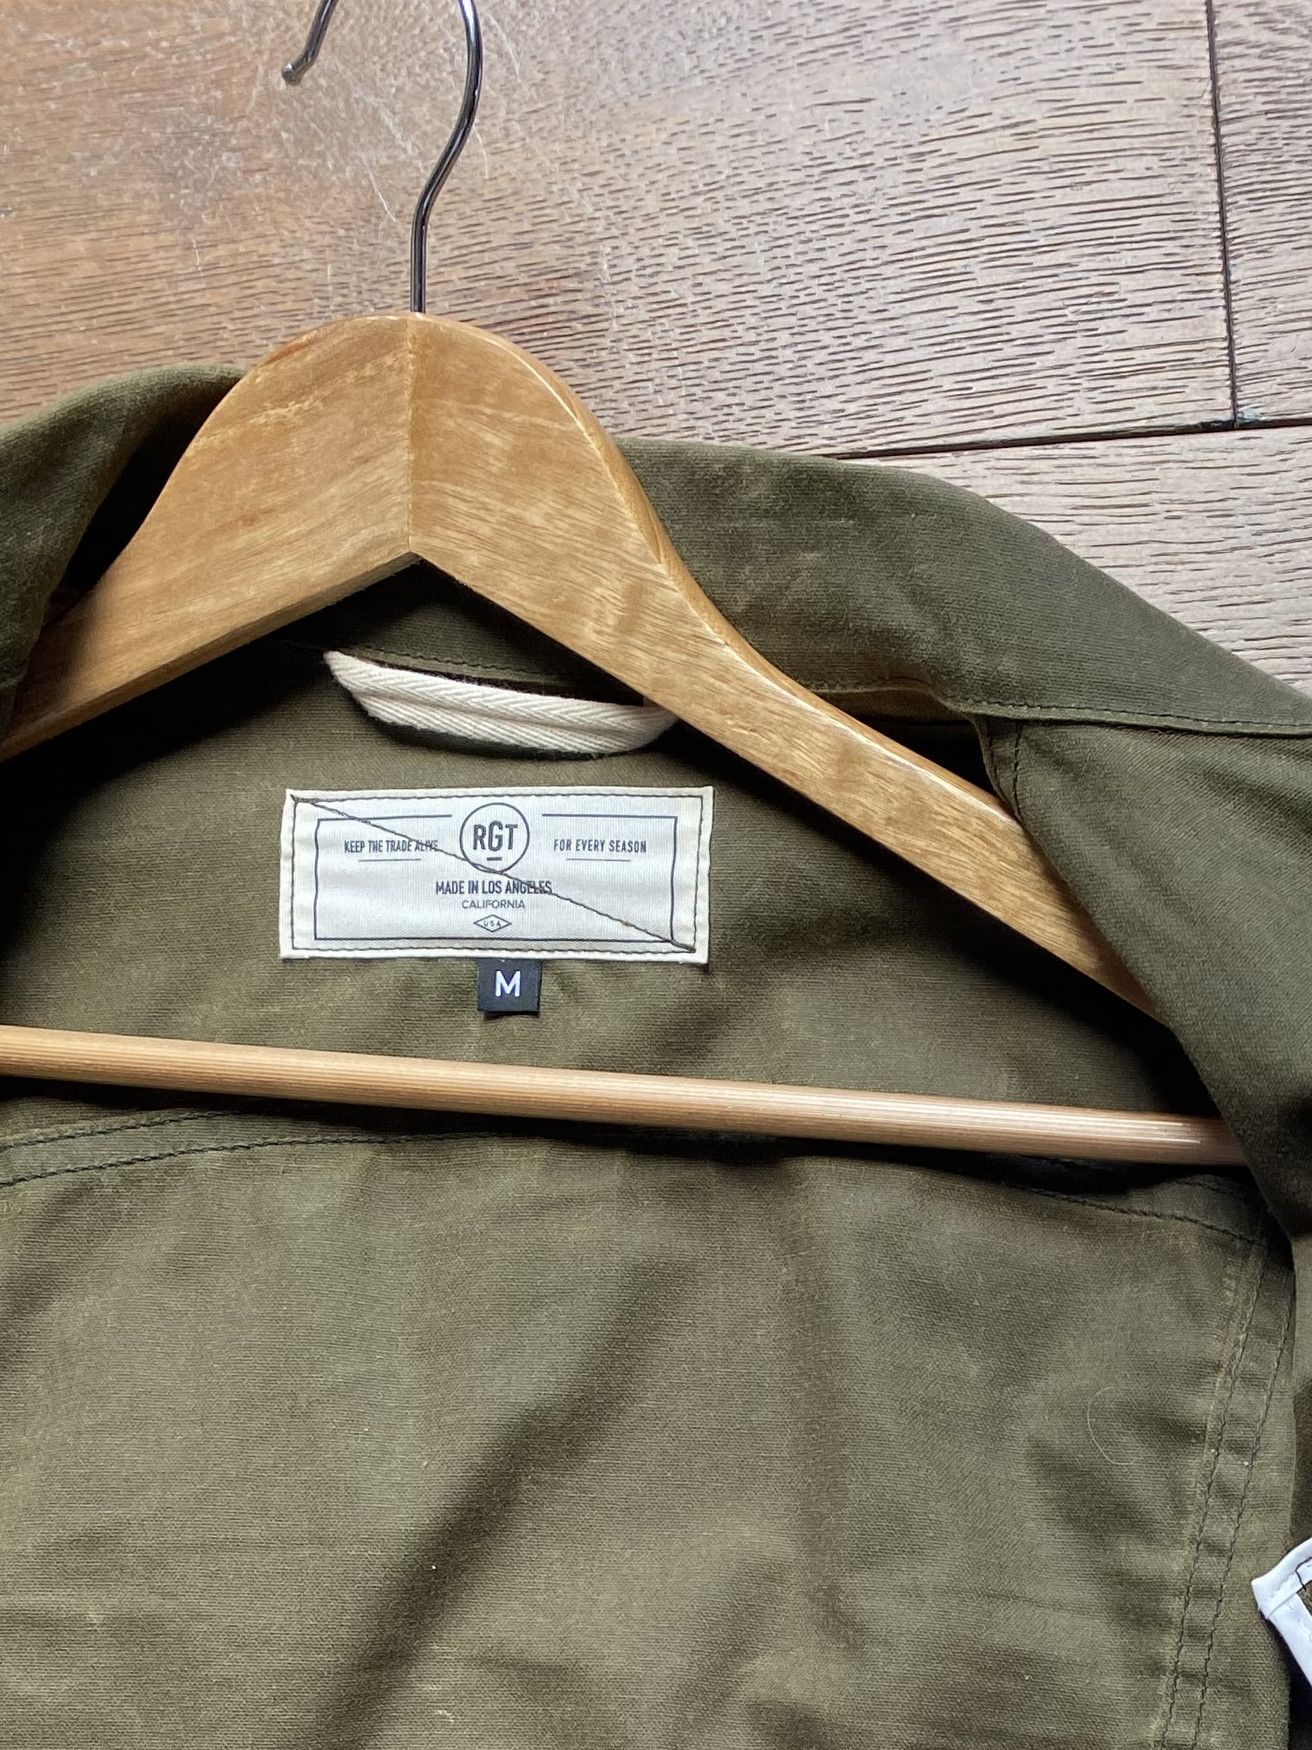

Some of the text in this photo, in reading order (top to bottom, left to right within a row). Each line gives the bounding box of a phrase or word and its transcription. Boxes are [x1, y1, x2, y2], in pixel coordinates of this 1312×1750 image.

[473, 820, 519, 851] RGT
[344, 840, 366, 853] KEEP
[368, 840, 383, 853] THE
[385, 839, 413, 852] TRADE
[553, 839, 647, 853] FOR EVERY SEASON
[435, 880, 553, 895] MADE IN LOS ANGELES
[461, 899, 526, 909] CALIFORNIA
[495, 970, 520, 997] M
